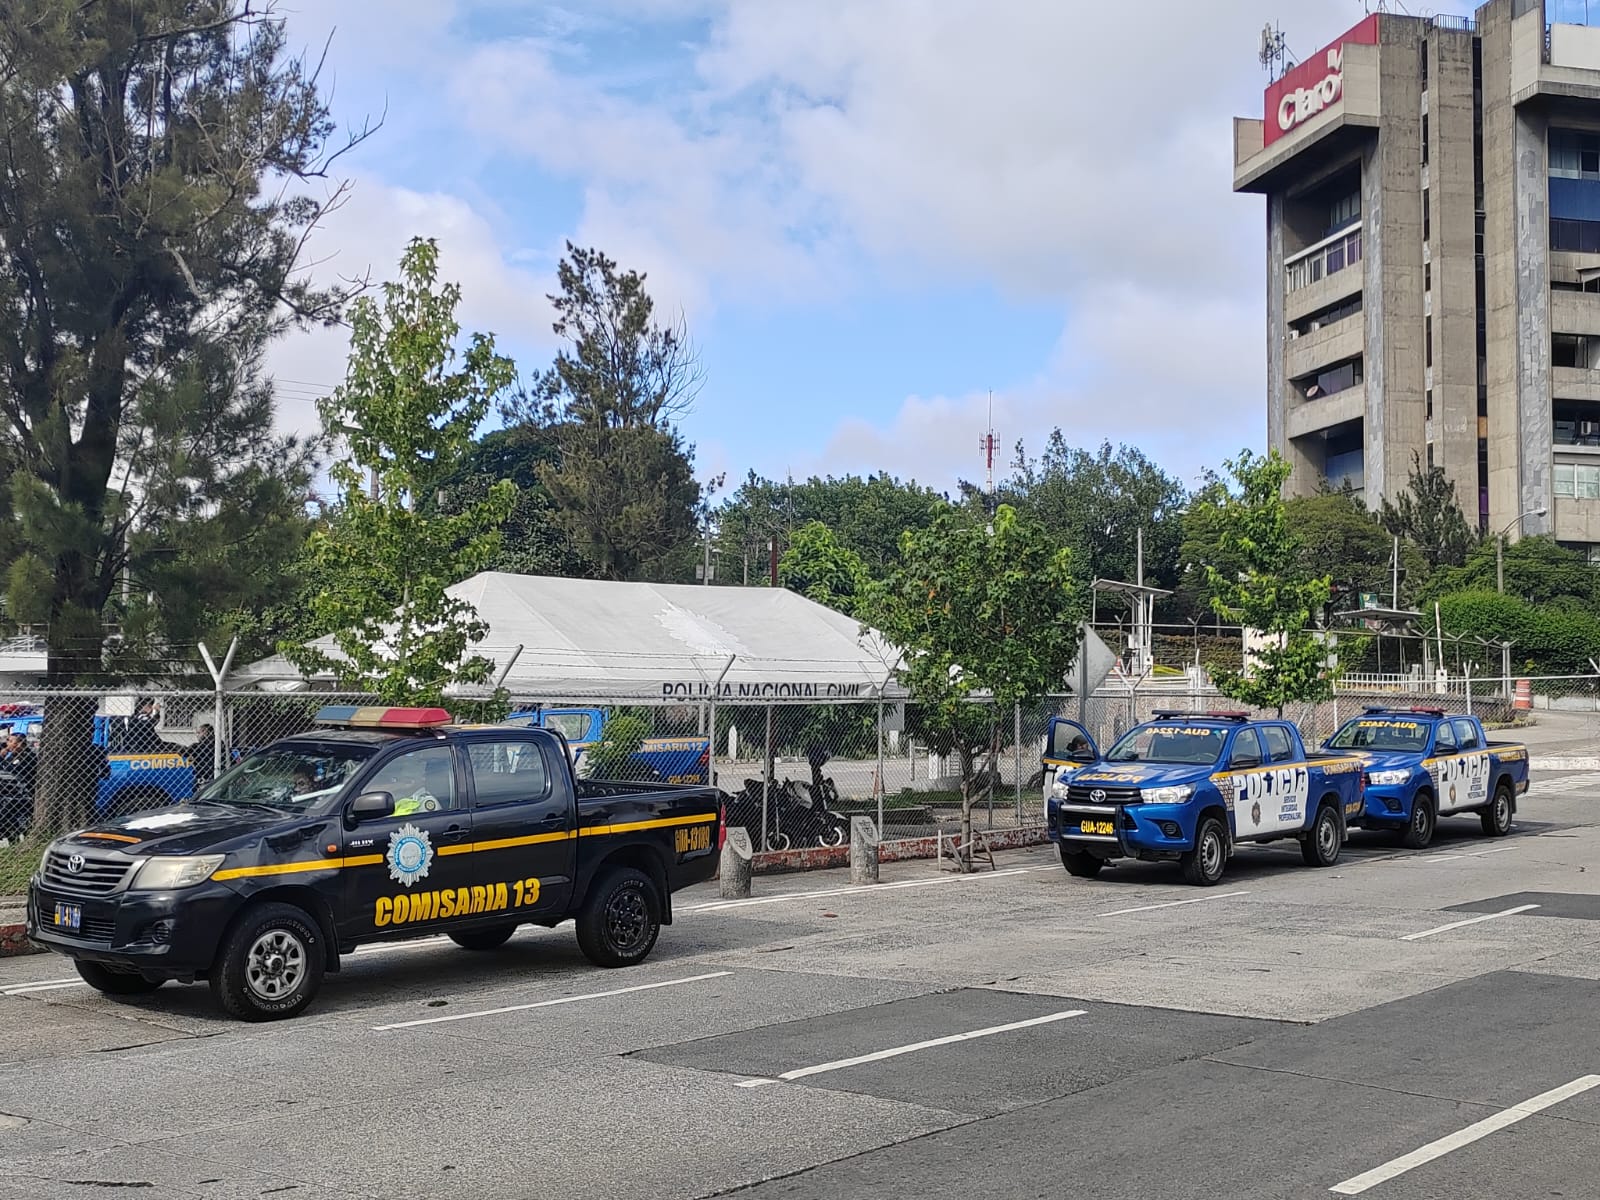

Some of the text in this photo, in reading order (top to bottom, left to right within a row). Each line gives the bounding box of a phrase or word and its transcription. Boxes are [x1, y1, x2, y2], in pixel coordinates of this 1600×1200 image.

[1278, 73, 1342, 131] Claro
[738, 682, 818, 701] NACIONAL
[1081, 820, 1114, 834] GUA-12246
[374, 877, 541, 927] COMISARIA 13
